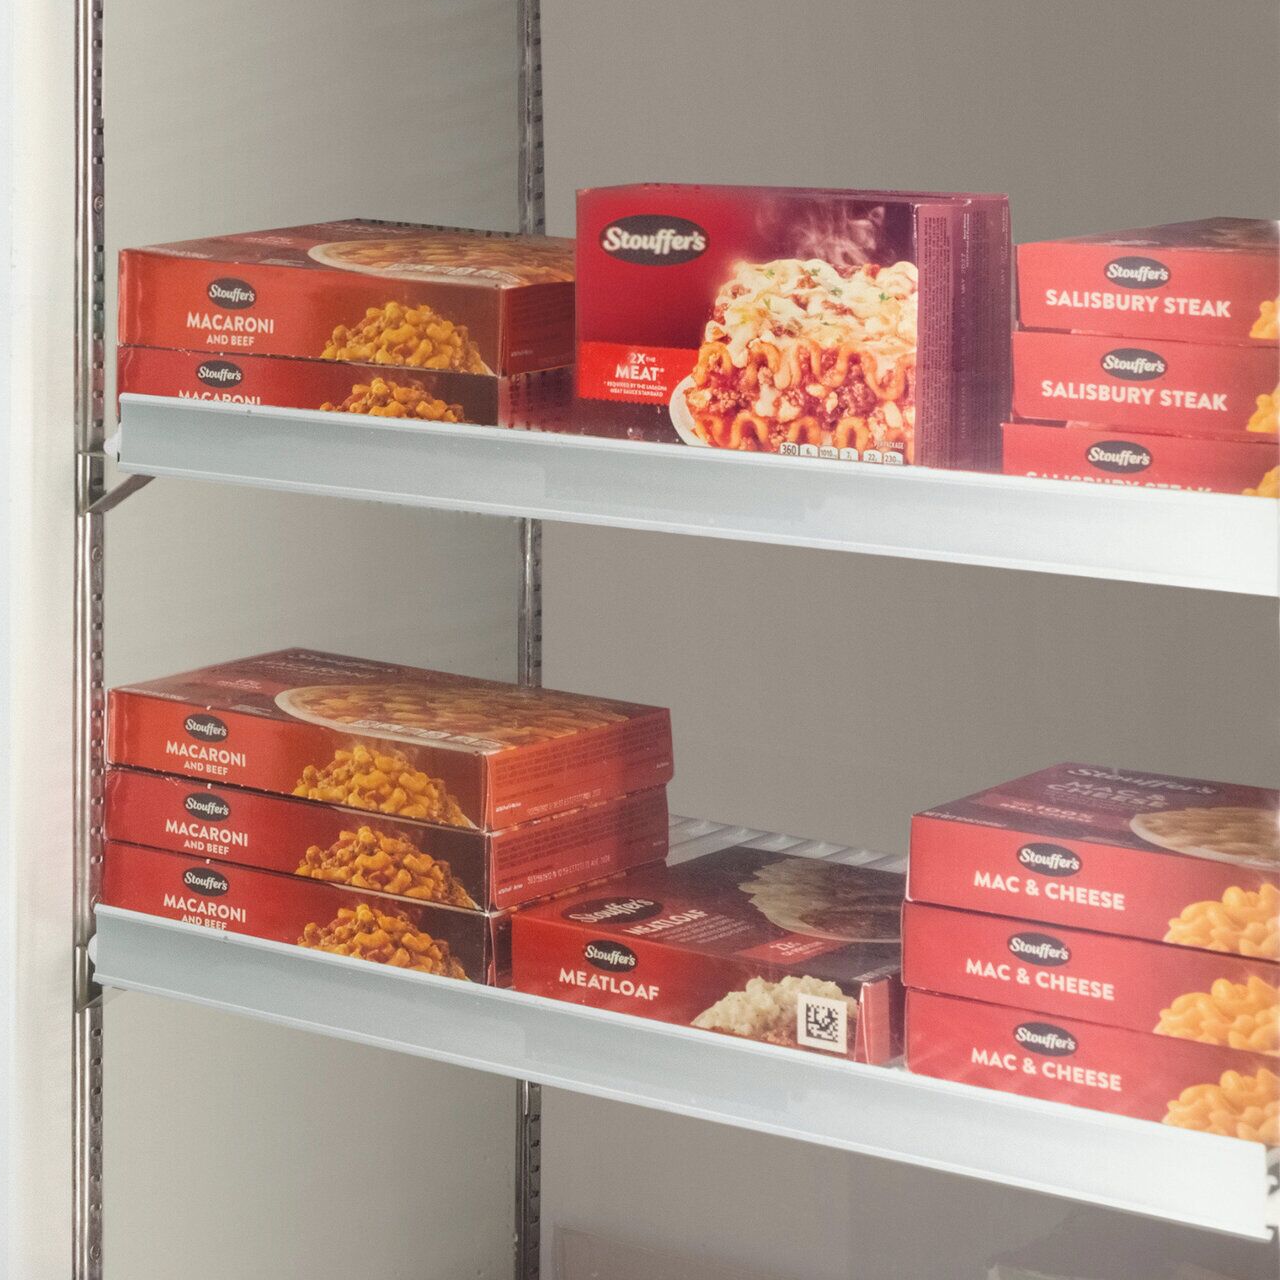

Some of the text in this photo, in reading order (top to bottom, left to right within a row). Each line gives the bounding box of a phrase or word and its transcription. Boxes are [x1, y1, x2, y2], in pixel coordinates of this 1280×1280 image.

[602, 226, 706, 255] Stouffer's
[1106, 263, 1169, 282] Stouffer's
[208, 283, 255, 303] Stouffer's
[1045, 289, 1232, 318] SALISBURY STEAK
[186, 311, 274, 334] MACARONI
[206, 333, 255, 347] AND BEEF
[197, 365, 242, 382] Stouffer's
[1041, 380, 1228, 411] SALISBURY STEAK
[165, 740, 246, 767] MACARONI
[183, 760, 229, 776] AND BEEF
[165, 819, 249, 847] MACARONI
[183, 839, 230, 855] AND BEEF
[973, 870, 1125, 911] MAC CHEESE
[163, 893, 247, 923] MACARONI
[623, 908, 709, 937] MEATLOAF
[558, 967, 660, 1001] MEATLOAF
[966, 958, 1115, 1001] MAC CHEESE
[971, 1047, 1122, 1092] MAC CHEESE
